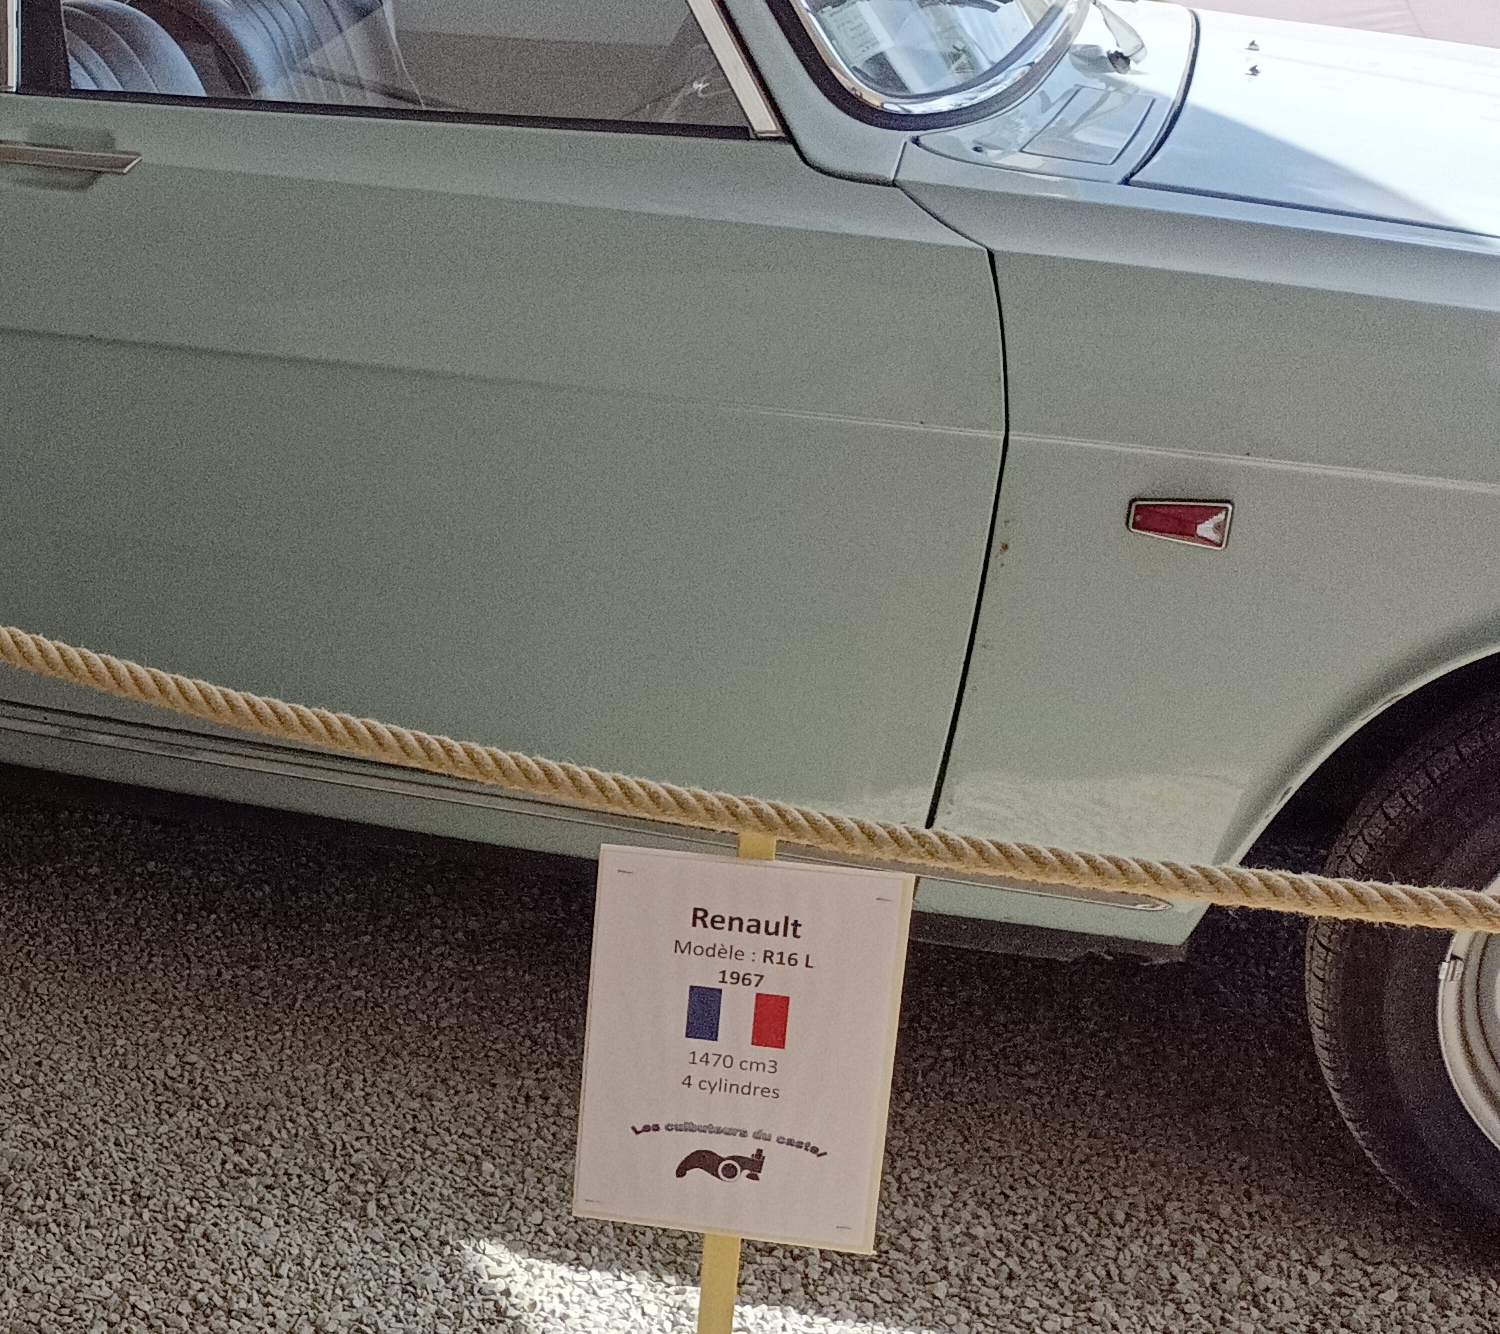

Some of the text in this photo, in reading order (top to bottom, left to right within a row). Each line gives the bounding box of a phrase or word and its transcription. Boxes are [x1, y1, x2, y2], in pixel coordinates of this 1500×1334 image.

[691, 906, 802, 939] Renault
[674, 939, 745, 961] Modèle
[762, 949, 799, 967] R16
[804, 953, 814, 969] L
[718, 969, 765, 988] 1967
[688, 1050, 778, 1074] 1470 cm3
[681, 1074, 780, 1099] 4 cylindres
[631, 1123, 661, 1135] Les
[752, 1129, 772, 1142] du
